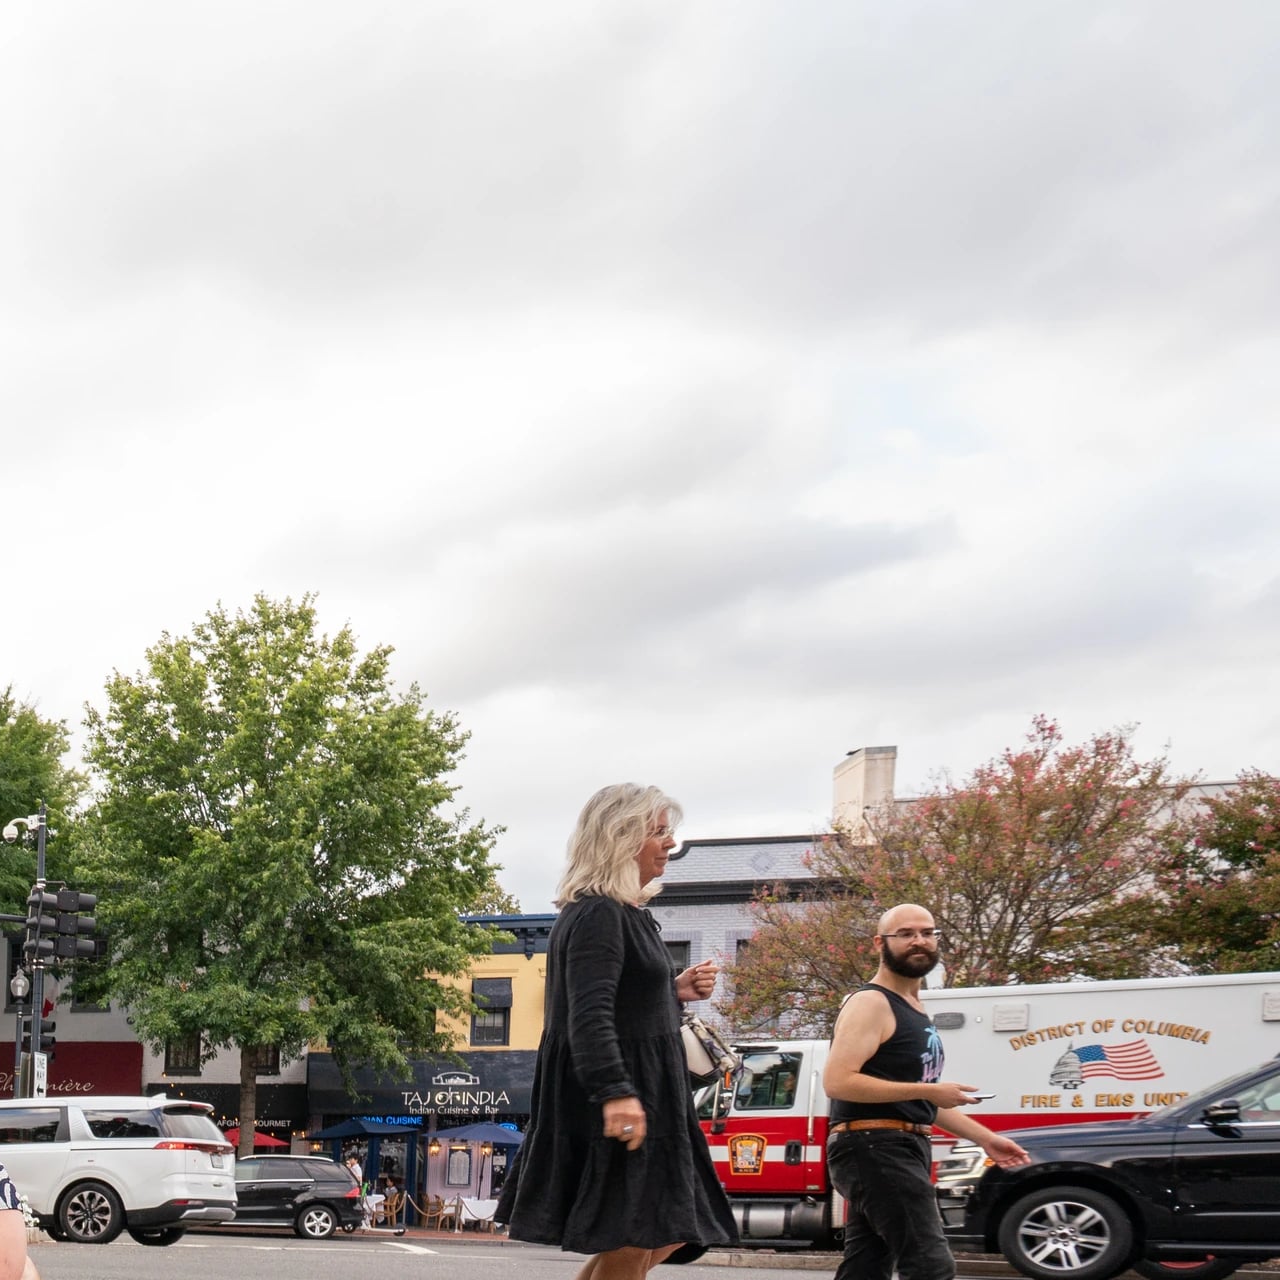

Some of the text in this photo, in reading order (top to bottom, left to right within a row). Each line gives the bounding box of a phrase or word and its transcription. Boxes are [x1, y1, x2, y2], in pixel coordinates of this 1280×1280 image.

[1009, 1018, 1212, 1051] DISTRICT OF COLUMBIA
[401, 1091, 510, 1105] TAJ OF INDIA
[1020, 1094, 1061, 1108] FIRE
[1071, 1094, 1084, 1107] &
[1095, 1093, 1135, 1107] EMS
[409, 1106, 499, 1114] Indian Cuisine & Bar
[386, 1115, 423, 1125] CUISINE
